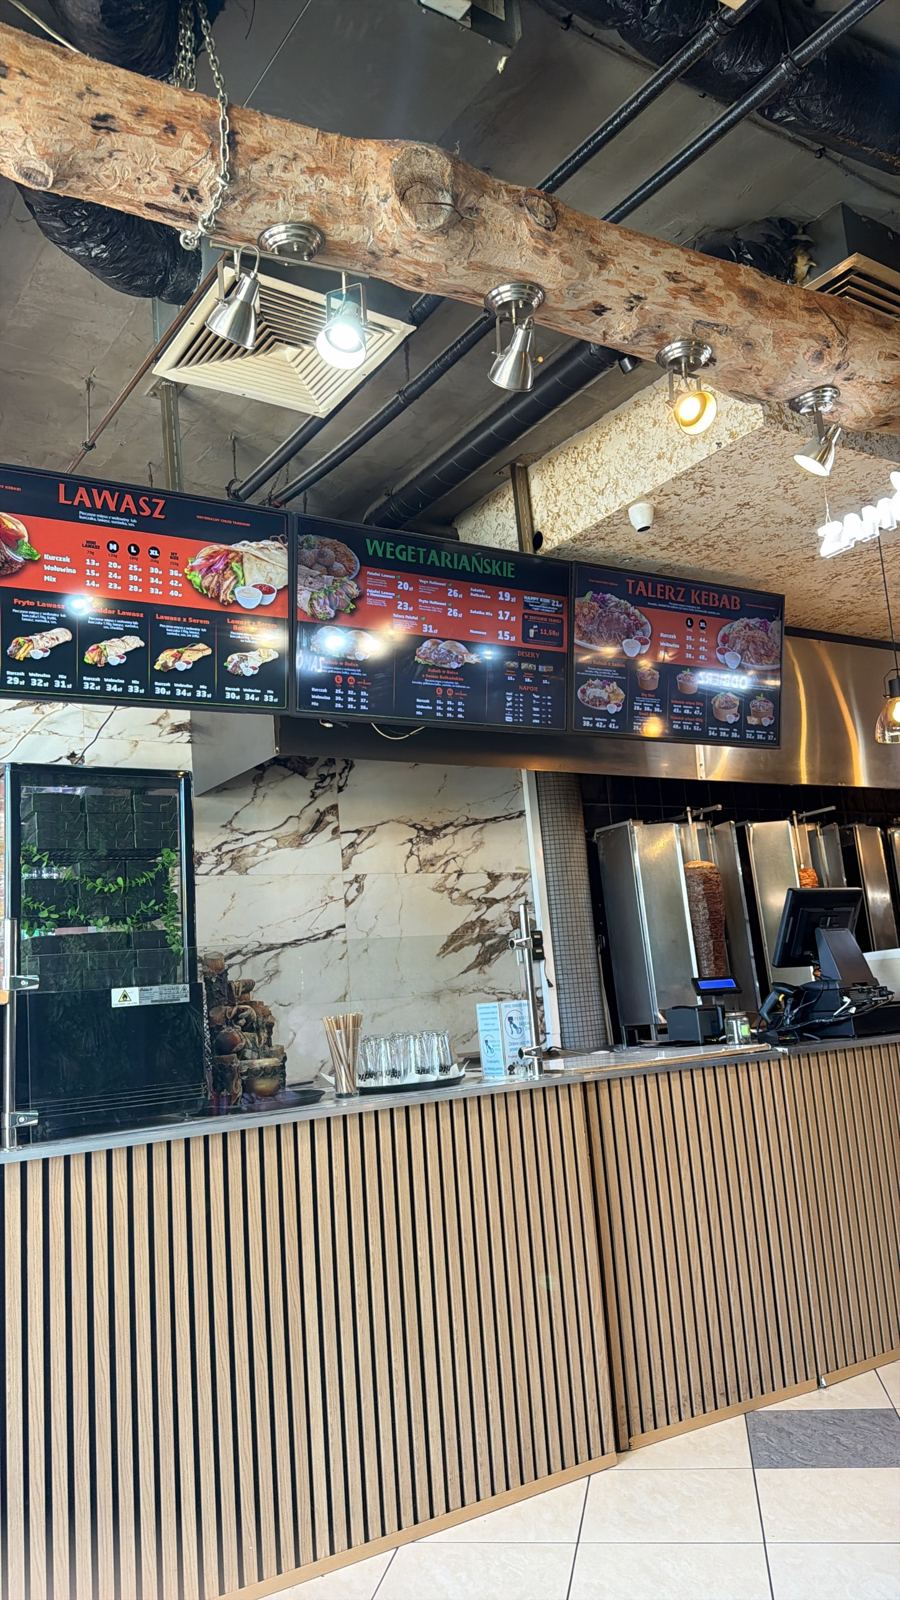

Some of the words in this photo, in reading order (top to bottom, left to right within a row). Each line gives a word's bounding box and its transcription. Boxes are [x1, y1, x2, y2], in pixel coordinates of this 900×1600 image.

[58, 482, 166, 520] LAWASZ
[44, 554, 71, 563] Kurczak
[365, 538, 516, 578] WEGETARIAŃSKIE
[626, 579, 686, 602] TALERZ
[691, 589, 741, 610] KEBAB
